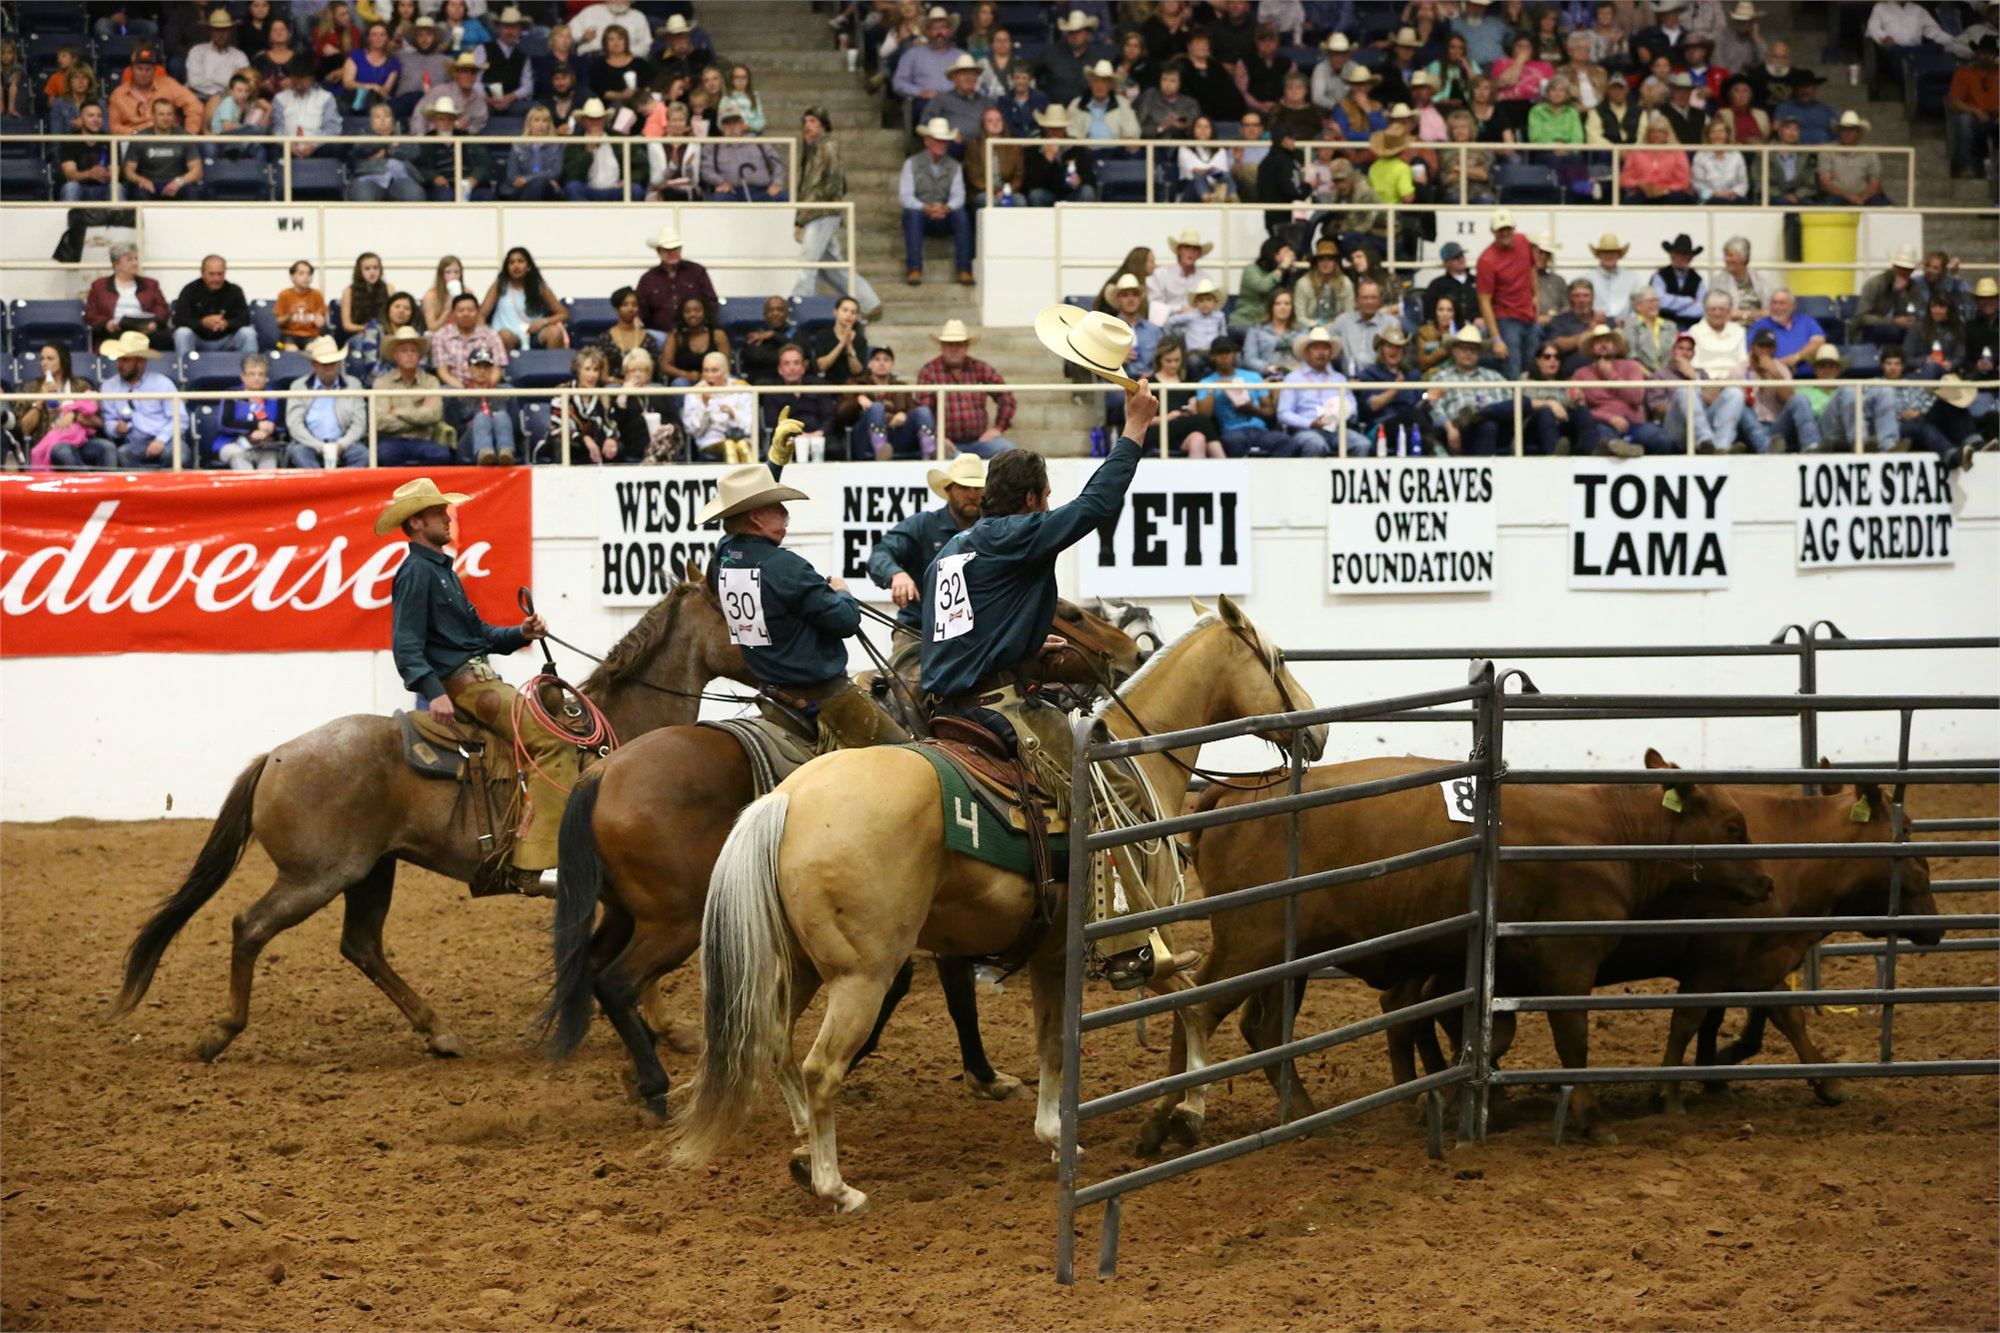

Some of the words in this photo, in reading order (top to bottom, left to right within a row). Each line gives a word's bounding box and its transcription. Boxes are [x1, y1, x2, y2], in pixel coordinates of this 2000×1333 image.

[1331, 468, 1391, 505] DIAN
[1400, 467, 1493, 504] GRAVES
[1573, 474, 1729, 520] TONY
[1798, 463, 1872, 508] LONE
[1880, 460, 1953, 506] STAR
[616, 478, 721, 533] WESTE
[843, 486, 928, 523] NEXT
[1376, 511, 1448, 543] OWEN
[1800, 517, 1840, 562] AG
[1848, 513, 1953, 560] CREDIT
[0, 499, 492, 616] dweiser
[1332, 550, 1494, 585] FOUNDATION
[1573, 532, 1728, 576] LAMA
[750, 569, 760, 588] 4
[940, 572, 966, 611] 32
[726, 591, 756, 620] 30
[936, 622, 946, 639] 4
[954, 796, 979, 849] 4
